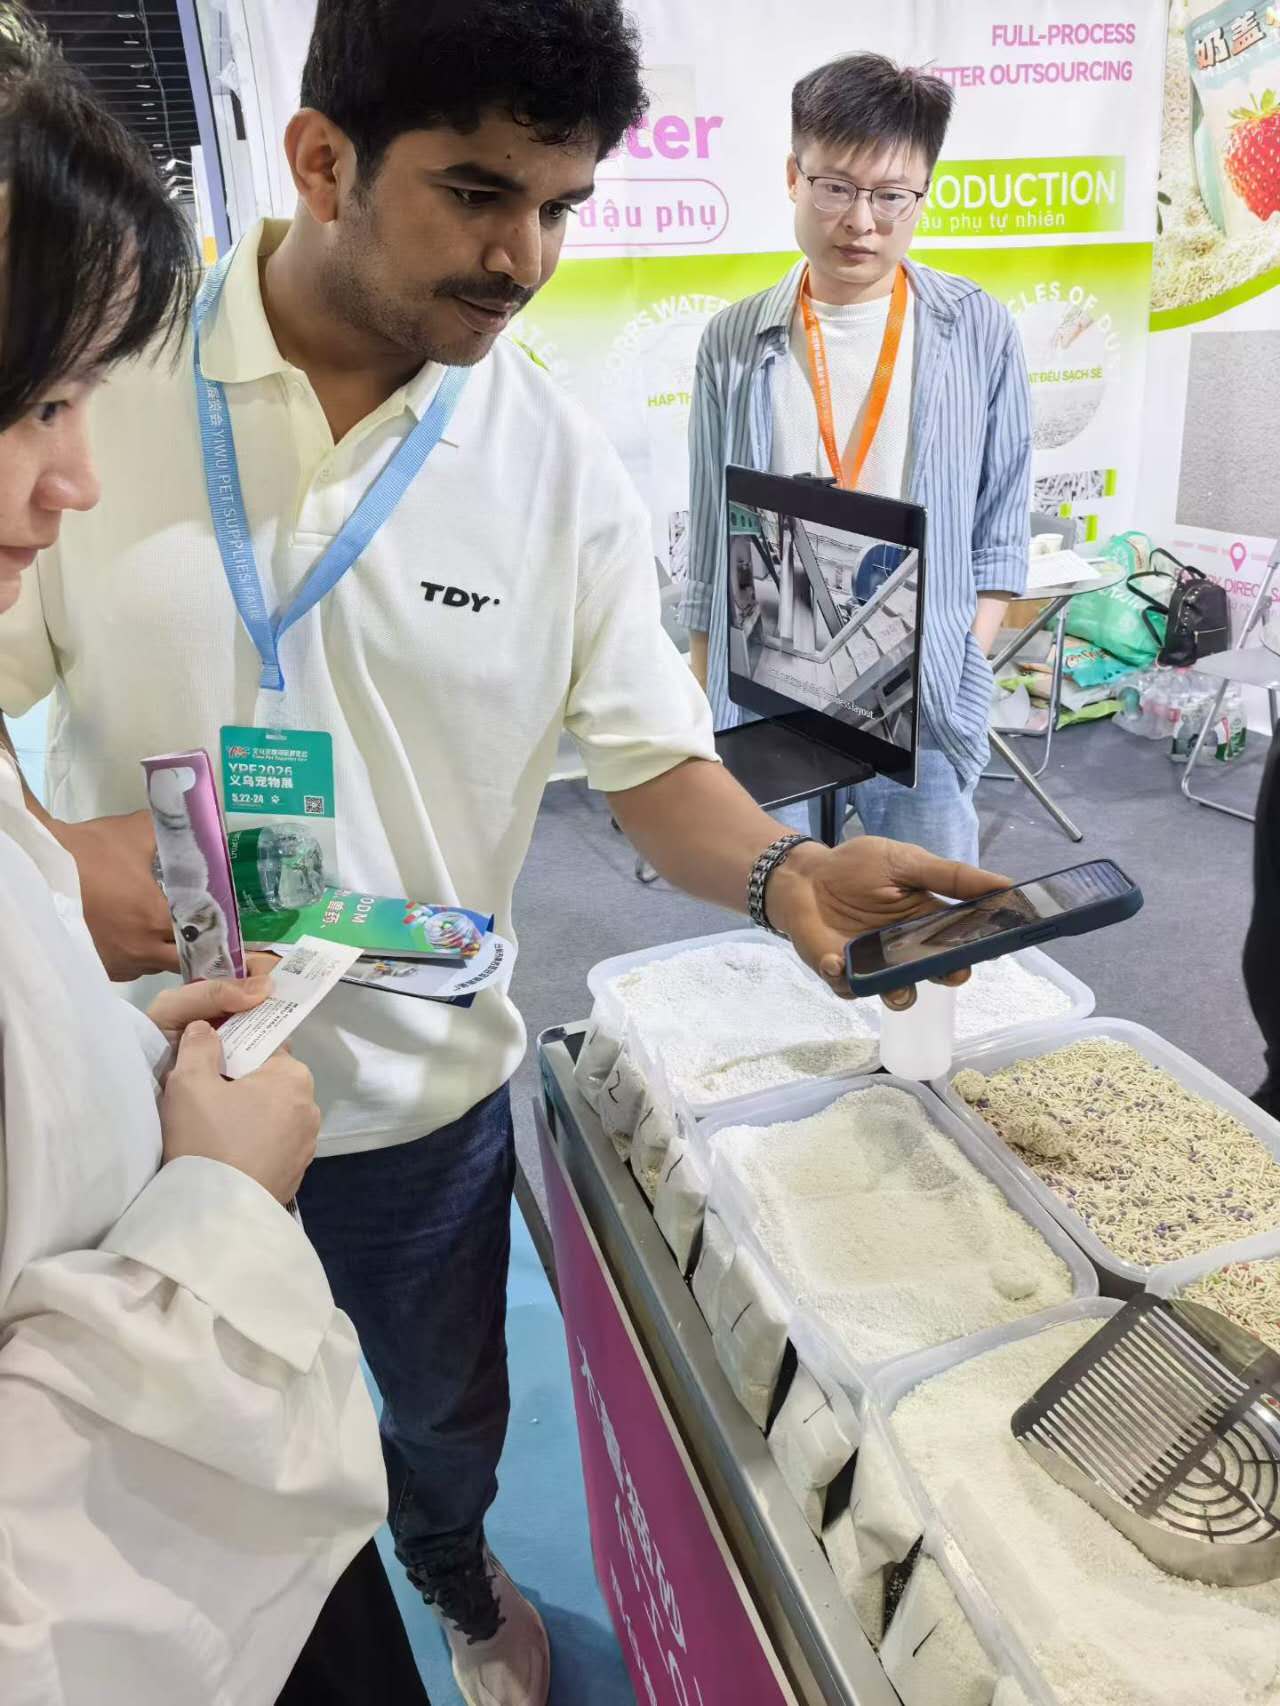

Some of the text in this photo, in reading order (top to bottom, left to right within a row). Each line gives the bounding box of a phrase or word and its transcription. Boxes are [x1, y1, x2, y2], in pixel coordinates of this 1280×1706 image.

[991, 23, 1136, 47] FULL-PROCESS
[989, 60, 1133, 85] OUTSOURCING
[656, 200, 717, 233] phụ
[920, 211, 943, 230] ậu
[215, 429, 228, 468] YIWU
[218, 474, 234, 503] PET
[224, 507, 251, 583] SUPPLIES
[1225, 578, 1262, 598] DIREC
